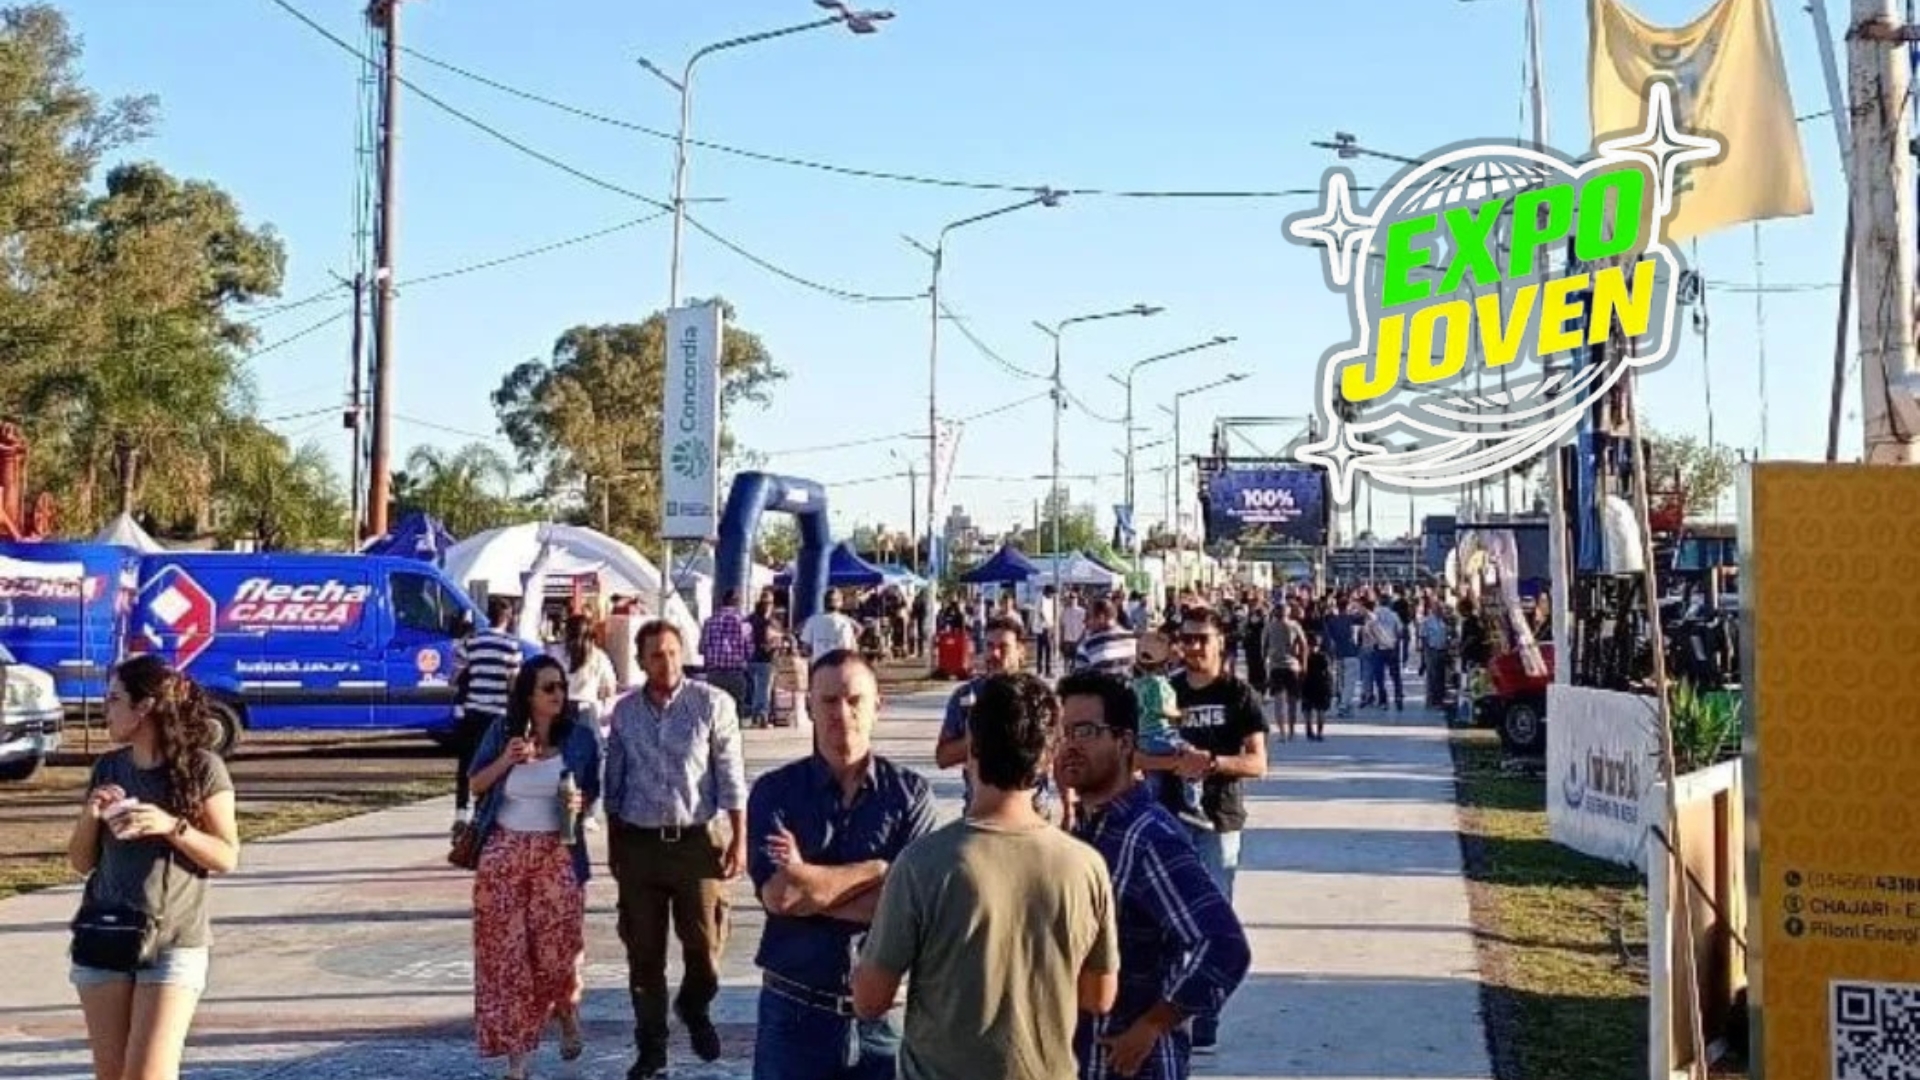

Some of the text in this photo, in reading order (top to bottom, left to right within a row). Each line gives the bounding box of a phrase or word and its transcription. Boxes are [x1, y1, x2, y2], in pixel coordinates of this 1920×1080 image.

[680, 325, 698, 432] Concordia
[1241, 488, 1295, 508] 100%
[233, 577, 368, 602] flecha
[228, 603, 350, 622] CARGA
[1183, 704, 1225, 728] ANS
